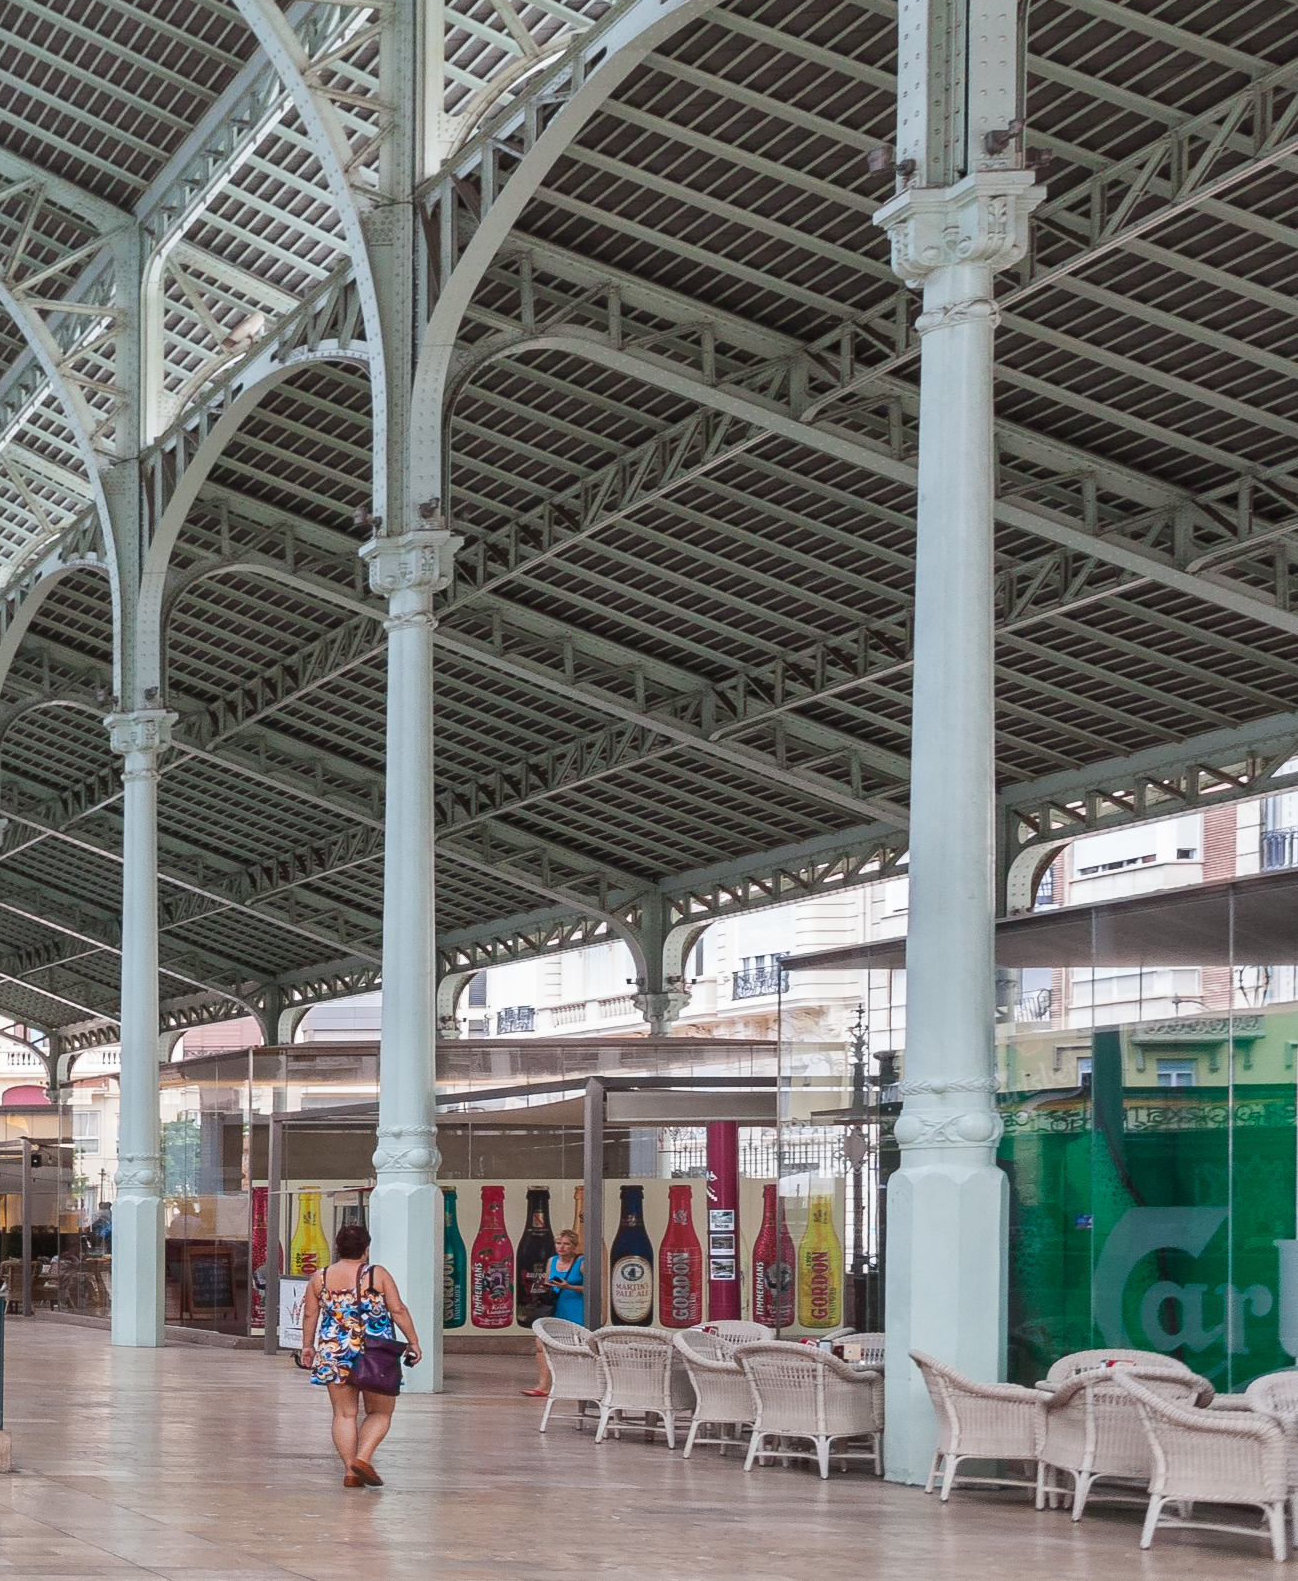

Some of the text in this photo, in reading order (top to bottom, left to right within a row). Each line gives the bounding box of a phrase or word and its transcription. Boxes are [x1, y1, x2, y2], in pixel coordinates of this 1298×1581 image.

[474, 1262, 482, 1316] TIMMERMANS
[672, 1252, 690, 1320] GORDON
[756, 1261, 764, 1316] TIMMERMANS
[811, 1252, 829, 1320] GORDON
